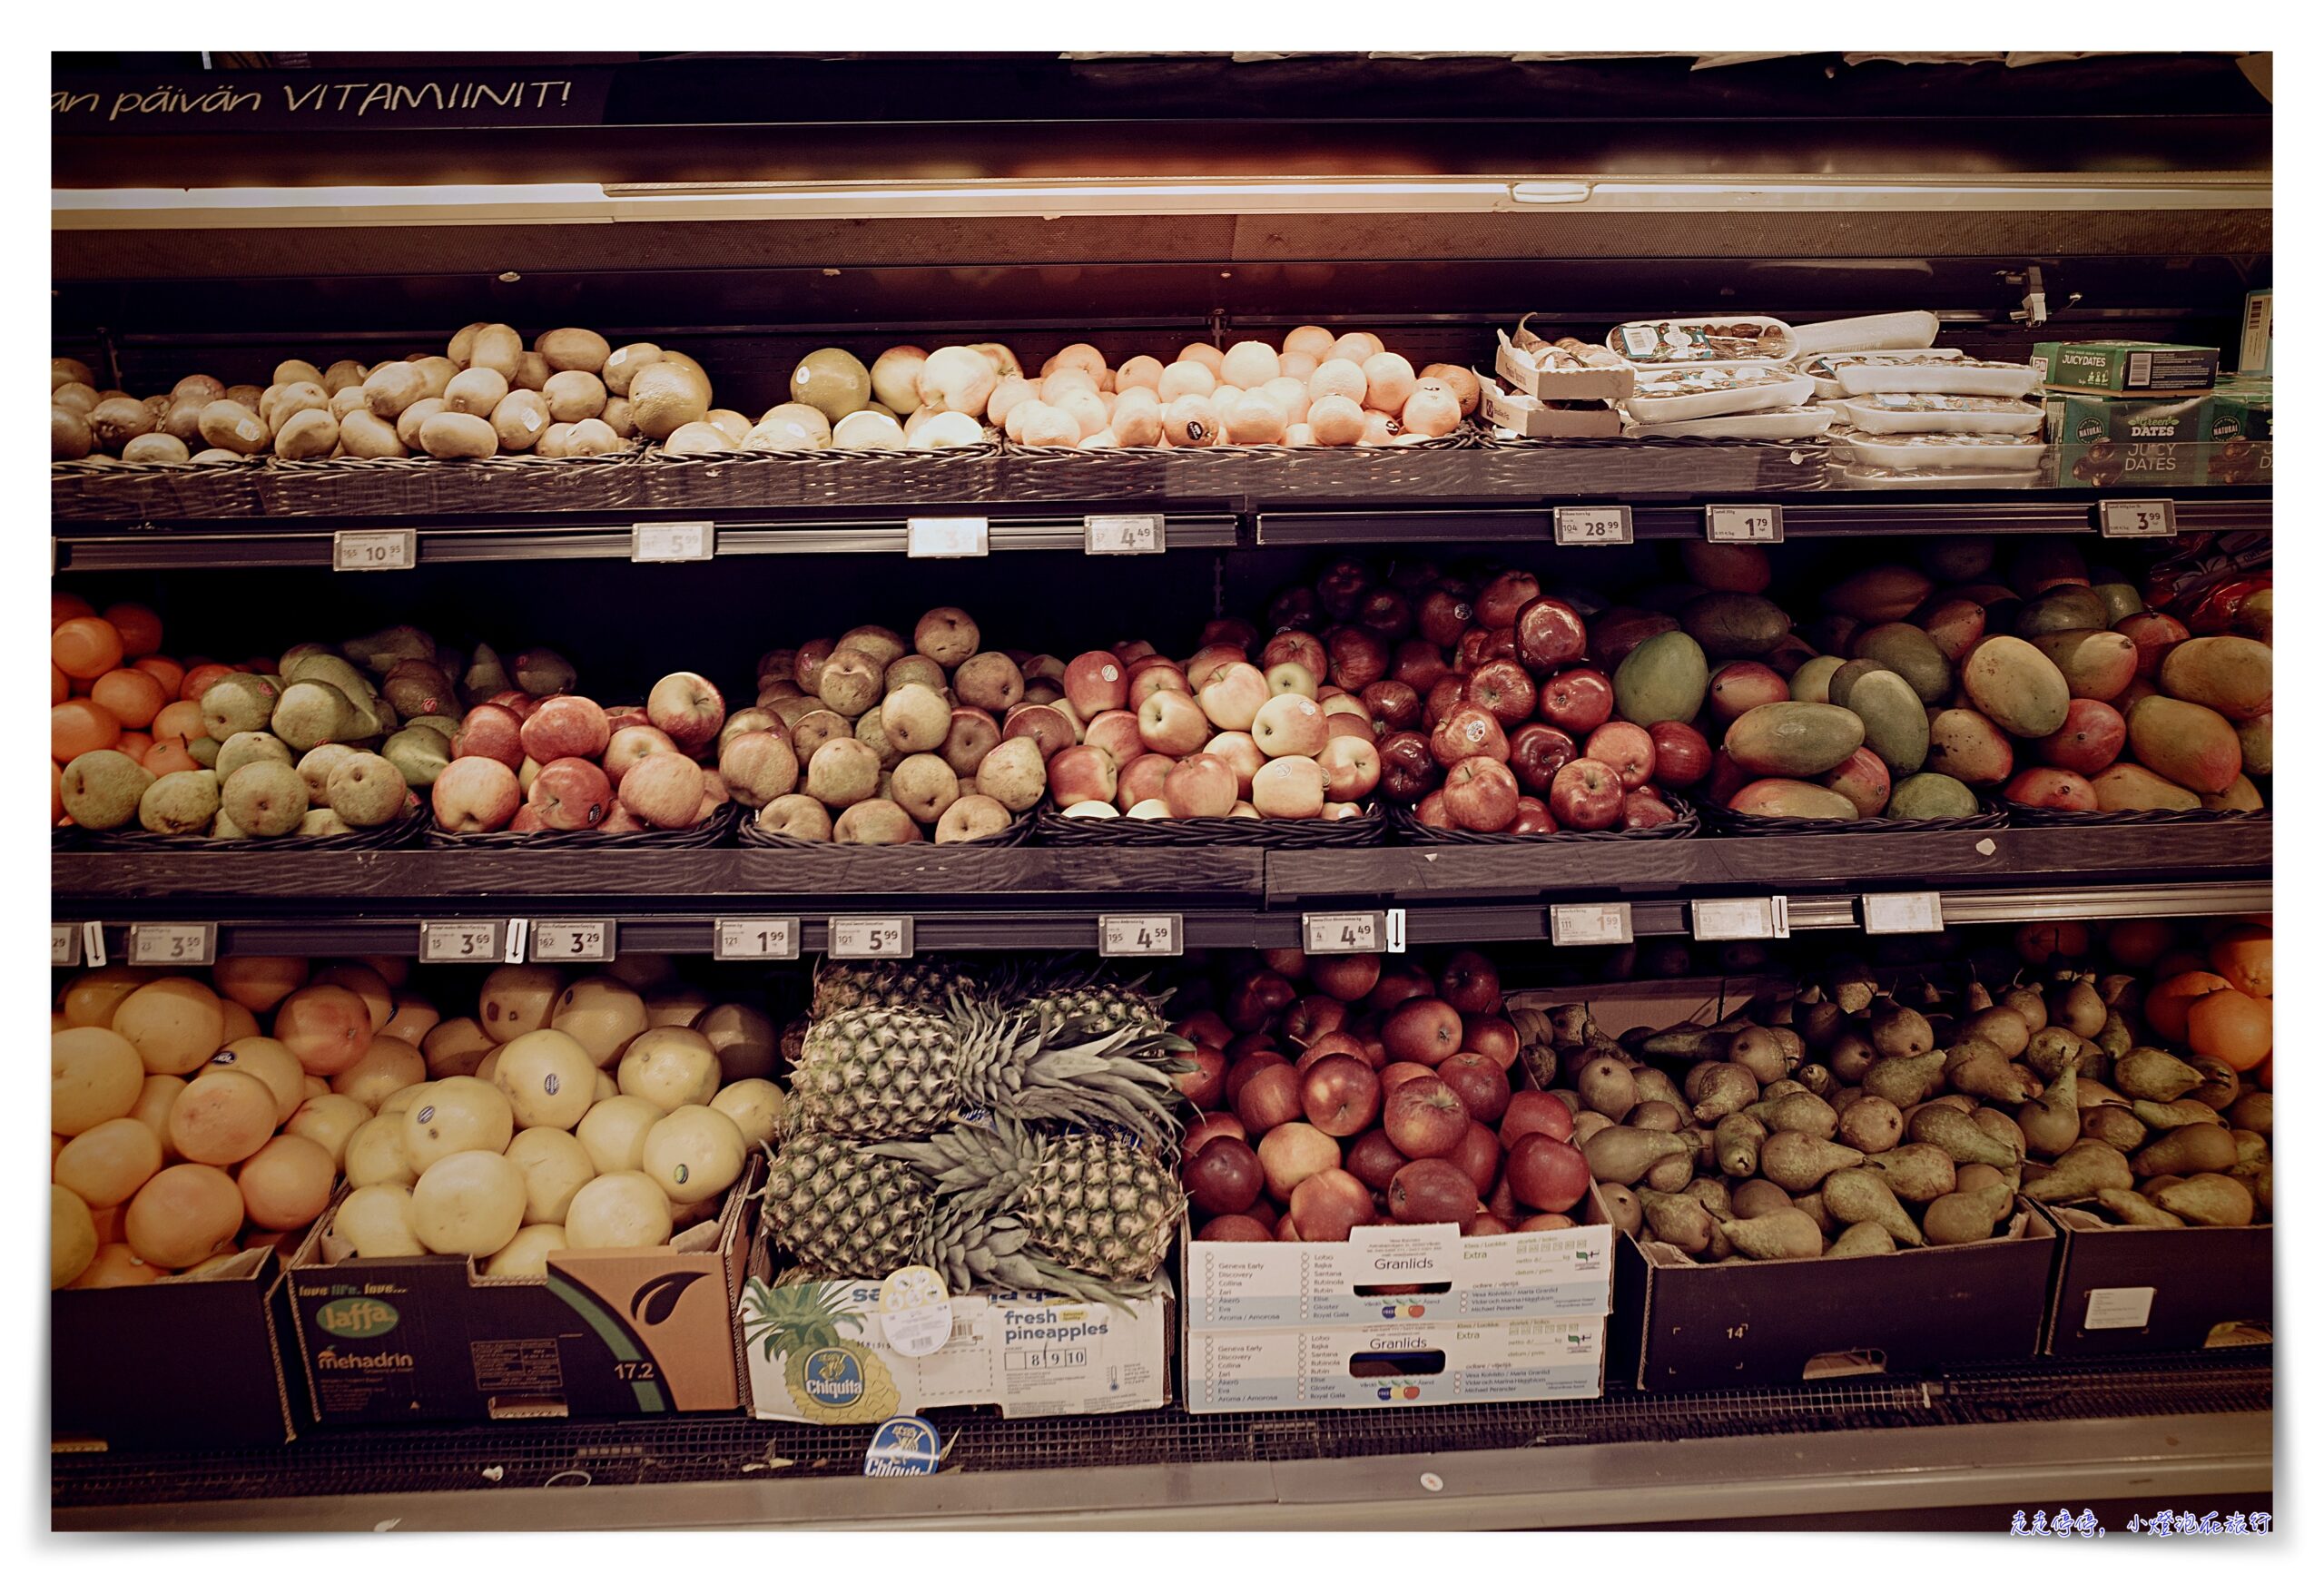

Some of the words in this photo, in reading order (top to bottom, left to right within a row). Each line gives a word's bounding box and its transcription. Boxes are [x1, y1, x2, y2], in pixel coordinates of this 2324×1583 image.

[110, 84, 262, 120] päivän
[283, 79, 572, 116] VITAMIINIT!
[2063, 355, 2083, 365] JUICY
[2083, 357, 2106, 367] DATES
[2140, 416, 2169, 427] Green
[2131, 427, 2175, 437] DATES
[2124, 457, 2177, 472] DATES
[1585, 522, 1606, 536] 28
[1607, 521, 1619, 529] 99
[1745, 518, 1755, 536] 1
[1757, 518, 1768, 526] 79
[2137, 513, 2149, 531] 3
[1121, 528, 1136, 547] 4
[1137, 528, 1151, 537] 49
[366, 546, 386, 561] 10
[1597, 916, 1605, 931] 1
[1606, 917, 1618, 925] 99
[461, 934, 474, 954] 3
[477, 934, 490, 944] 69
[571, 933, 584, 953] 3
[586, 933, 600, 942] 29
[757, 931, 767, 951] 1
[770, 931, 784, 941] 99
[869, 930, 882, 950] 5
[884, 930, 898, 939] 99
[1137, 928, 1152, 948] 4
[1155, 928, 1167, 937] 59
[1341, 925, 1355, 945] 4
[1358, 925, 1371, 934] 49
[171, 937, 184, 957] 3
[1374, 1258, 1433, 1270] Granlids
[1463, 1251, 1487, 1259] Extra
[1247, 1263, 1264, 1271] Early
[325, 1302, 389, 1332] laffa
[1004, 1308, 1058, 1325] fresh
[1005, 1322, 1108, 1344] pineapples
[1457, 1332, 1480, 1340] Extra
[1727, 1327, 1744, 1339] 14
[1370, 1337, 1427, 1350] Granlids
[319, 1351, 414, 1370] mehadrin
[1031, 1353, 1039, 1366] 8
[1051, 1352, 1059, 1365] 9
[1068, 1352, 1084, 1364] 10
[614, 1362, 655, 1380] 17.2
[806, 1378, 862, 1399] Chiquita
[864, 1458, 929, 1478] Chiquit
